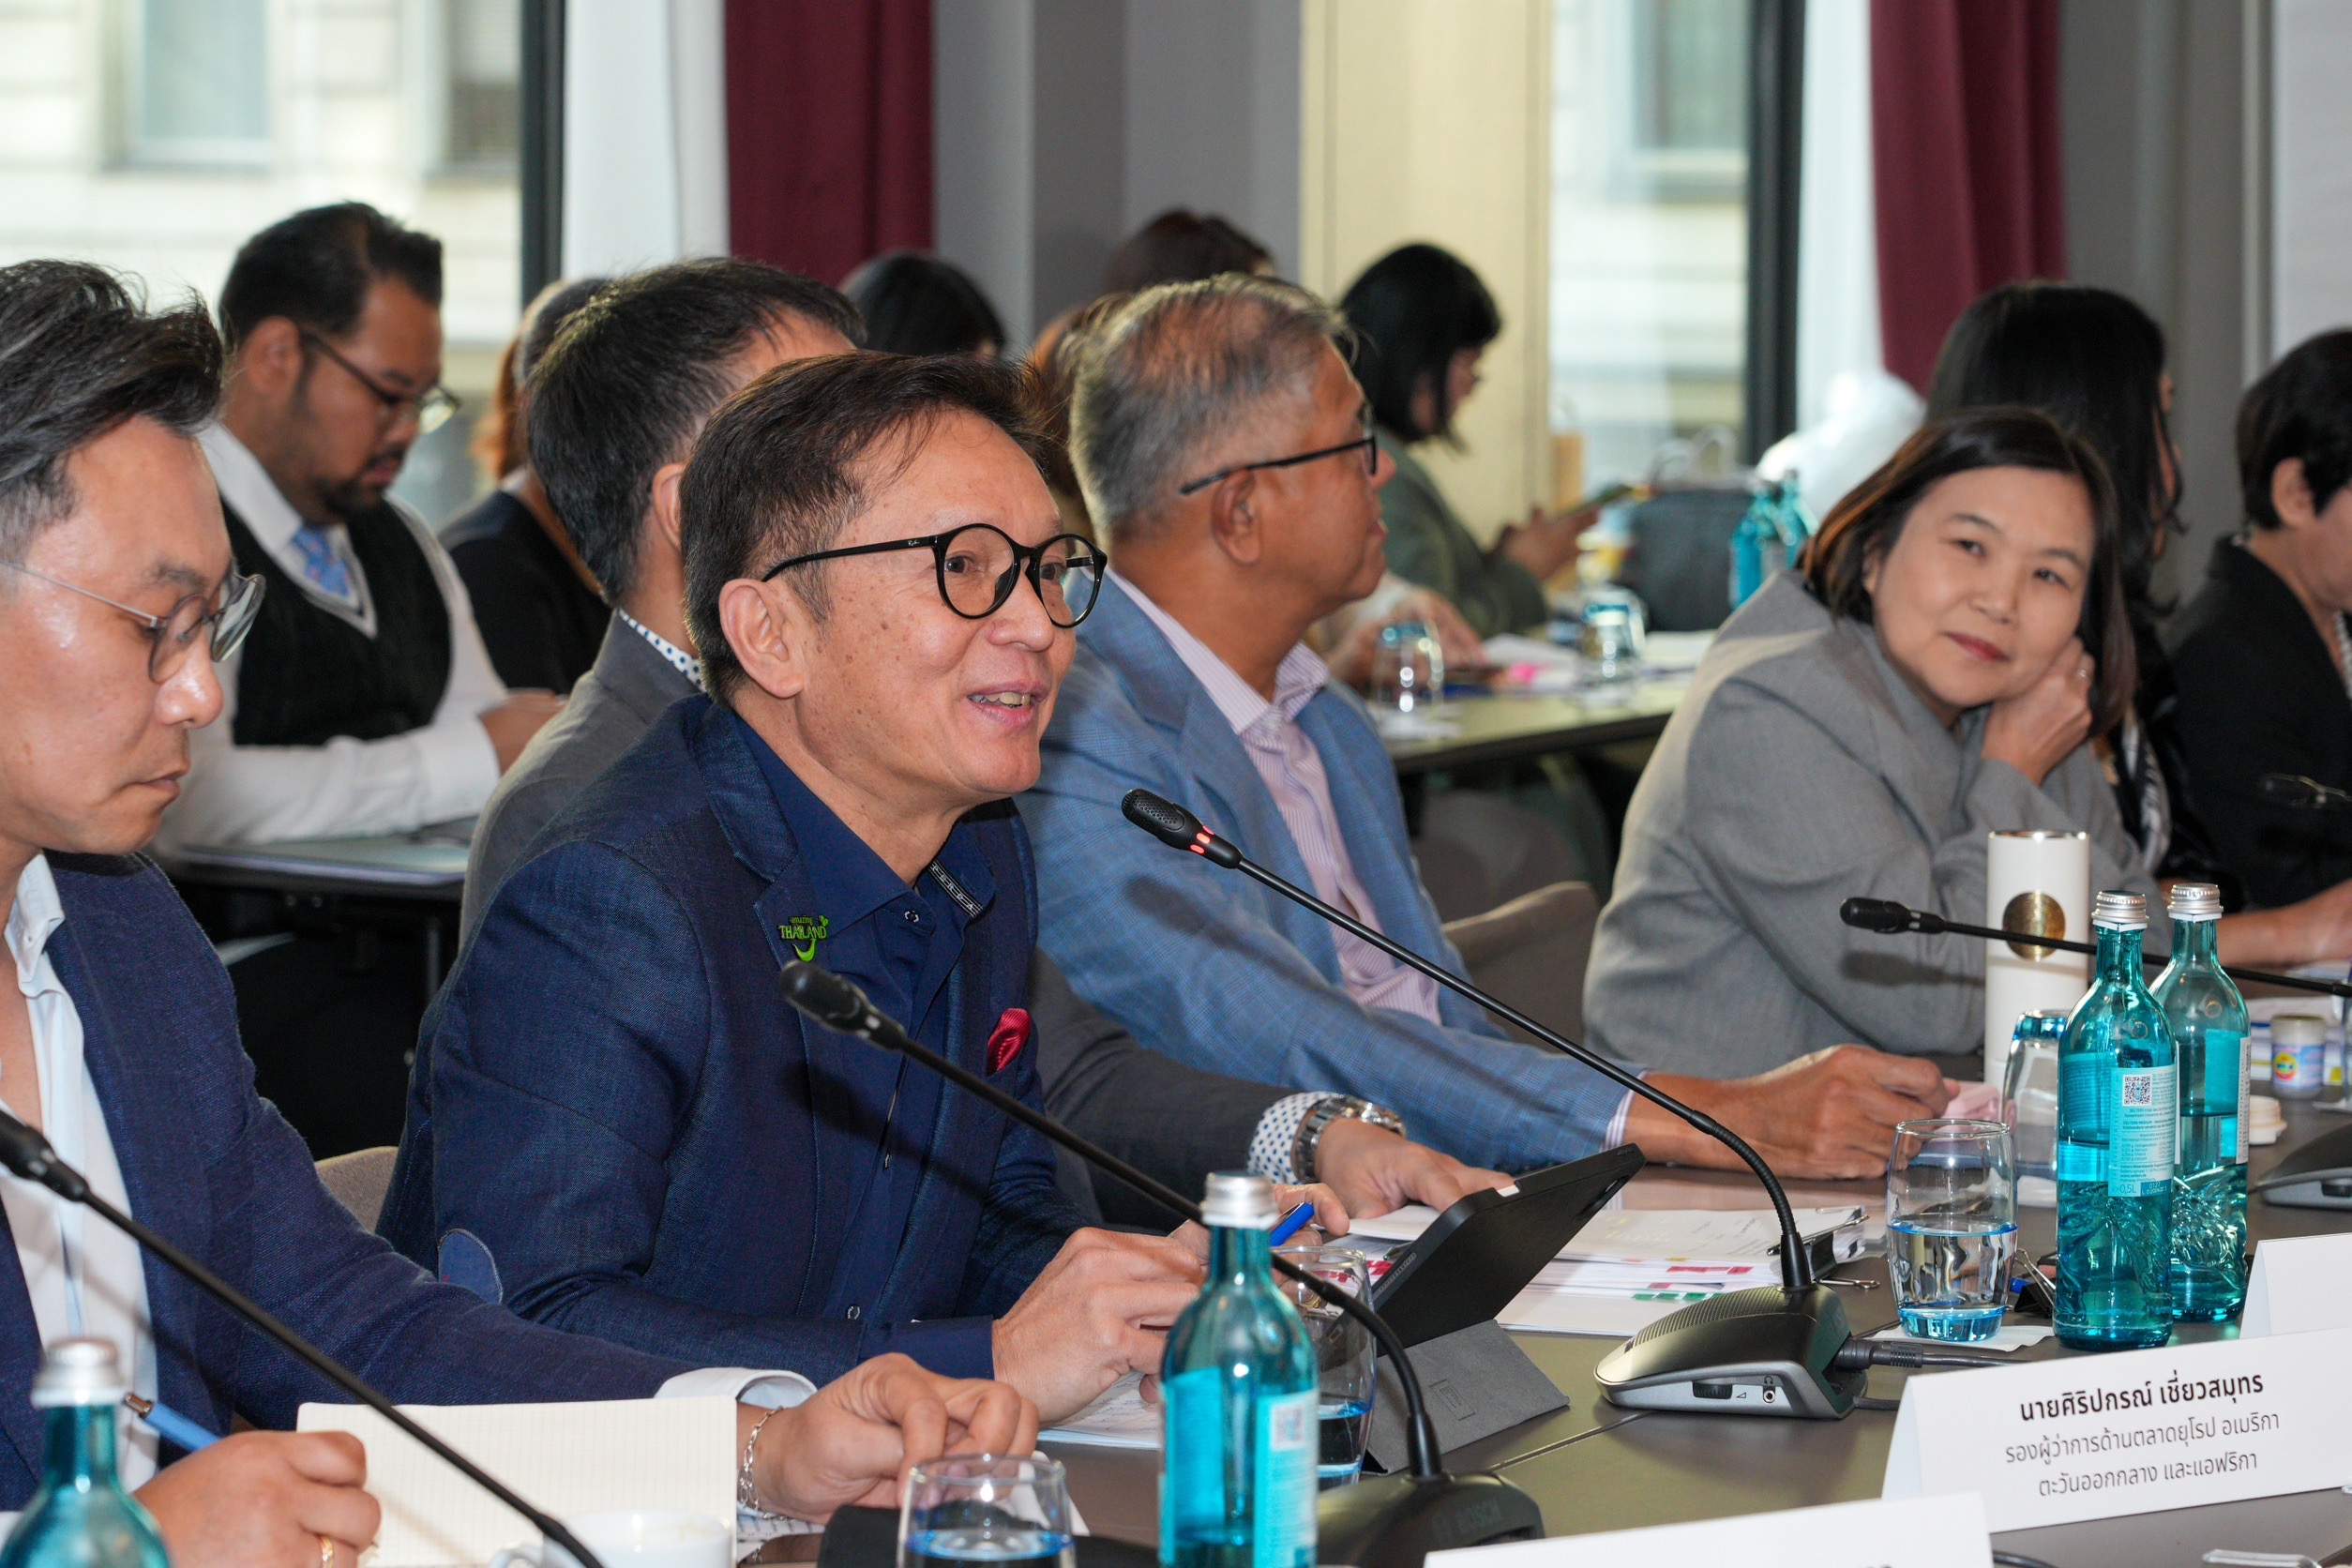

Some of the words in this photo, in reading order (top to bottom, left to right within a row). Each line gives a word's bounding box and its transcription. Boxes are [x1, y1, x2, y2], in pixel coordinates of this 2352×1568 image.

[778, 925, 827, 939] THAILAND
[2119, 1184, 2137, 1195] 0,5L
[2020, 1380, 2153, 1421] นายศิริปกรณ์
[2160, 1369, 2264, 1404] เชี่ยวสมุทร
[2005, 1416, 2216, 1465] รองผู้ว่าการด้านตลาดยุโรป
[2222, 1411, 2280, 1436] อเมริกา
[2039, 1466, 2158, 1497] ตะวันออกกลาง
[2164, 1451, 2258, 1480] และแอฟริกา
